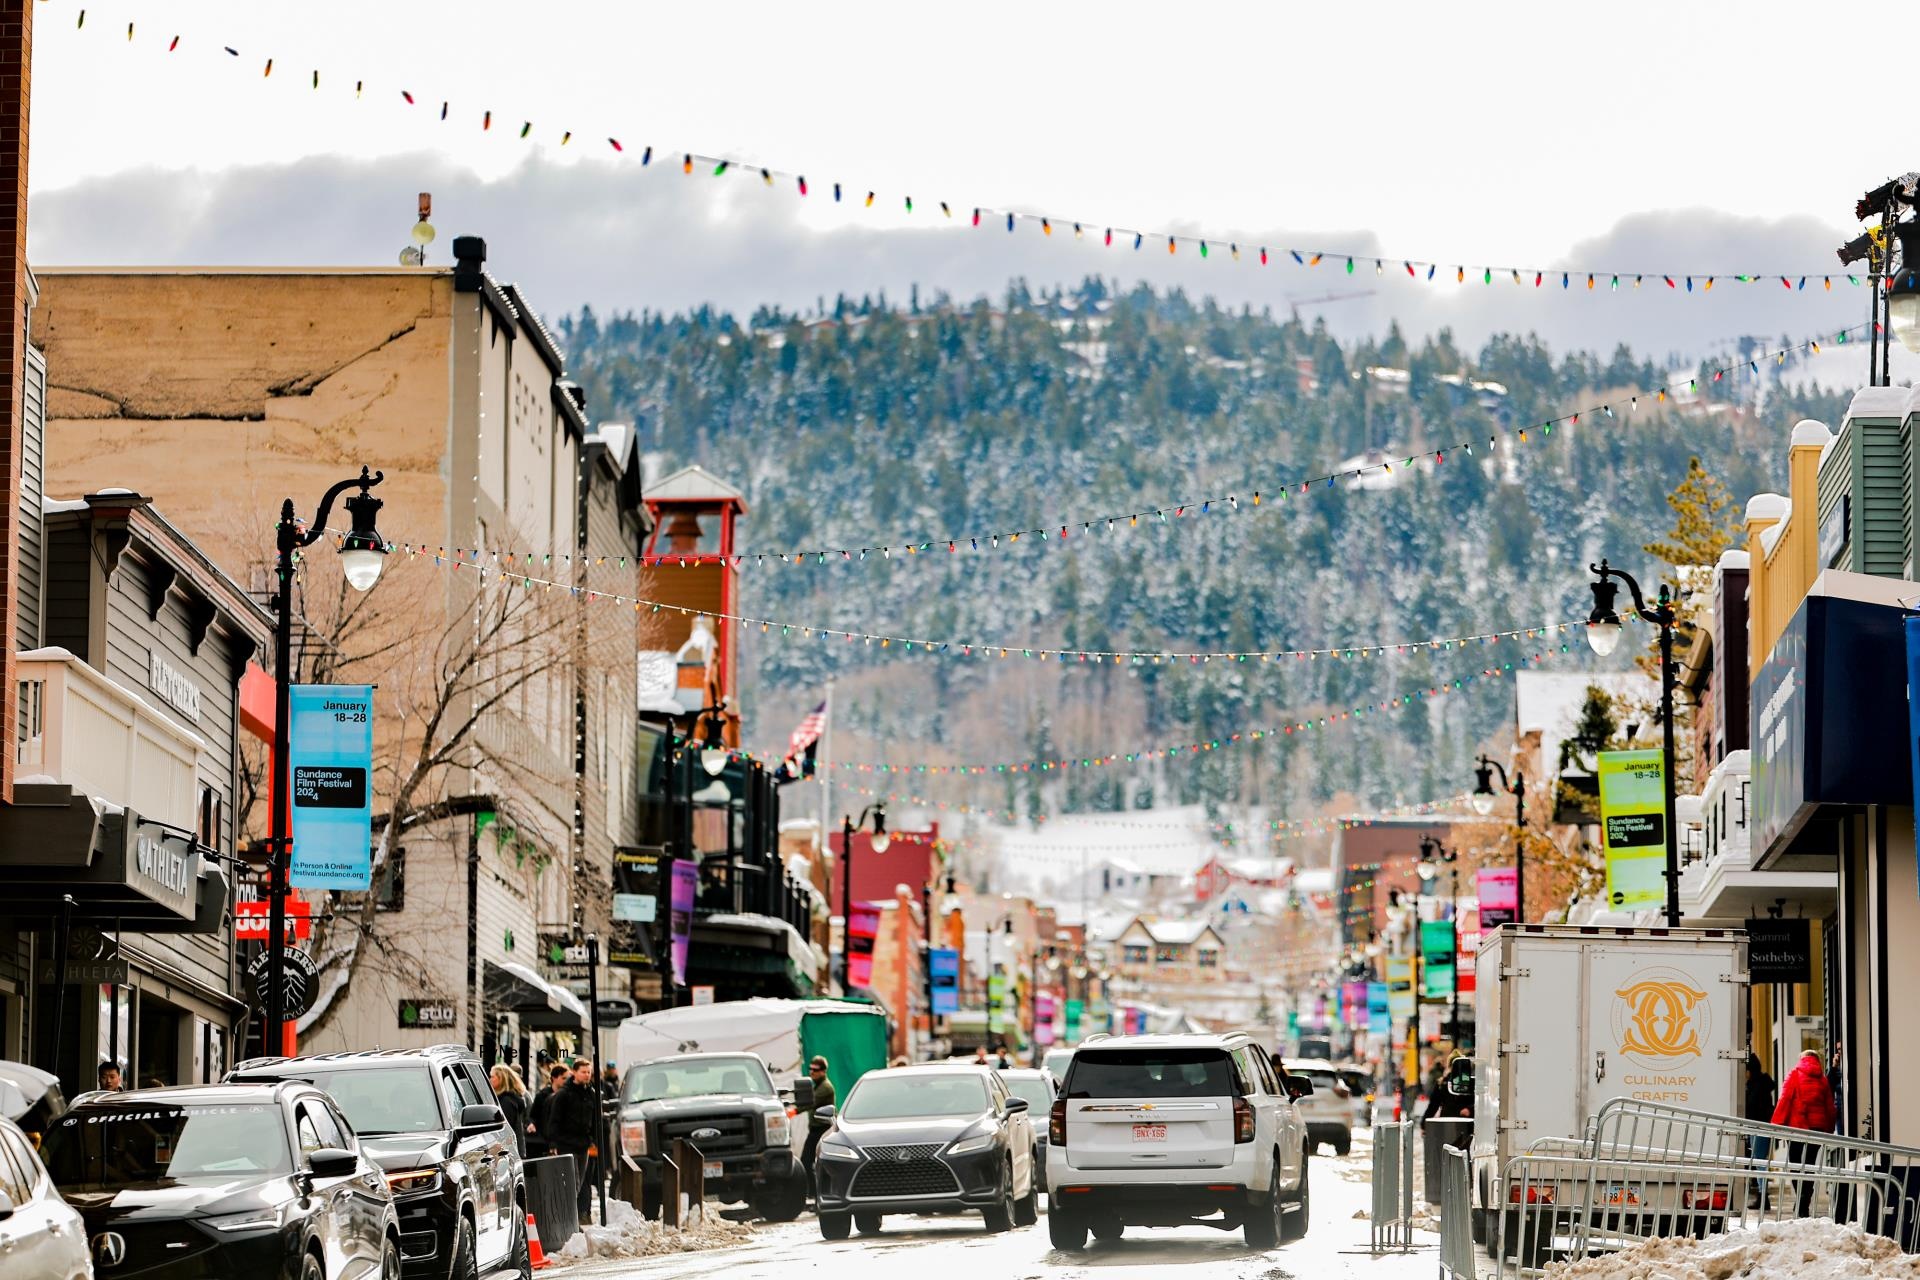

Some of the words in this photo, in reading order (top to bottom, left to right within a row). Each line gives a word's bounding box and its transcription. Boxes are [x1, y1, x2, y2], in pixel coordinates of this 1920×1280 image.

[323, 701, 367, 712] January
[1624, 763, 1660, 771] January
[297, 769, 342, 779] Sundance
[296, 779, 316, 788] Film
[318, 779, 352, 788] Festival
[296, 788, 319, 801] 2024
[1608, 817, 1645, 825] Sundance
[1625, 823, 1654, 832] Festival
[1610, 832, 1629, 842] 2024
[144, 838, 188, 898] ATHLETA
[300, 862, 323, 870] Person
[293, 869, 364, 879] festival.sundance.org
[236, 908, 297, 932] doe
[1751, 932, 1791, 942] Summit
[247, 947, 317, 977] FLEHER'S
[1751, 951, 1805, 965] Sotheby's
[44, 966, 123, 980] AHLETA
[1624, 1075, 1697, 1086] CULINARY
[1632, 1091, 1689, 1102] CRAFTS
[87, 1111, 161, 1124] OFFICIAL
[168, 1107, 238, 1118] VEHICLE
